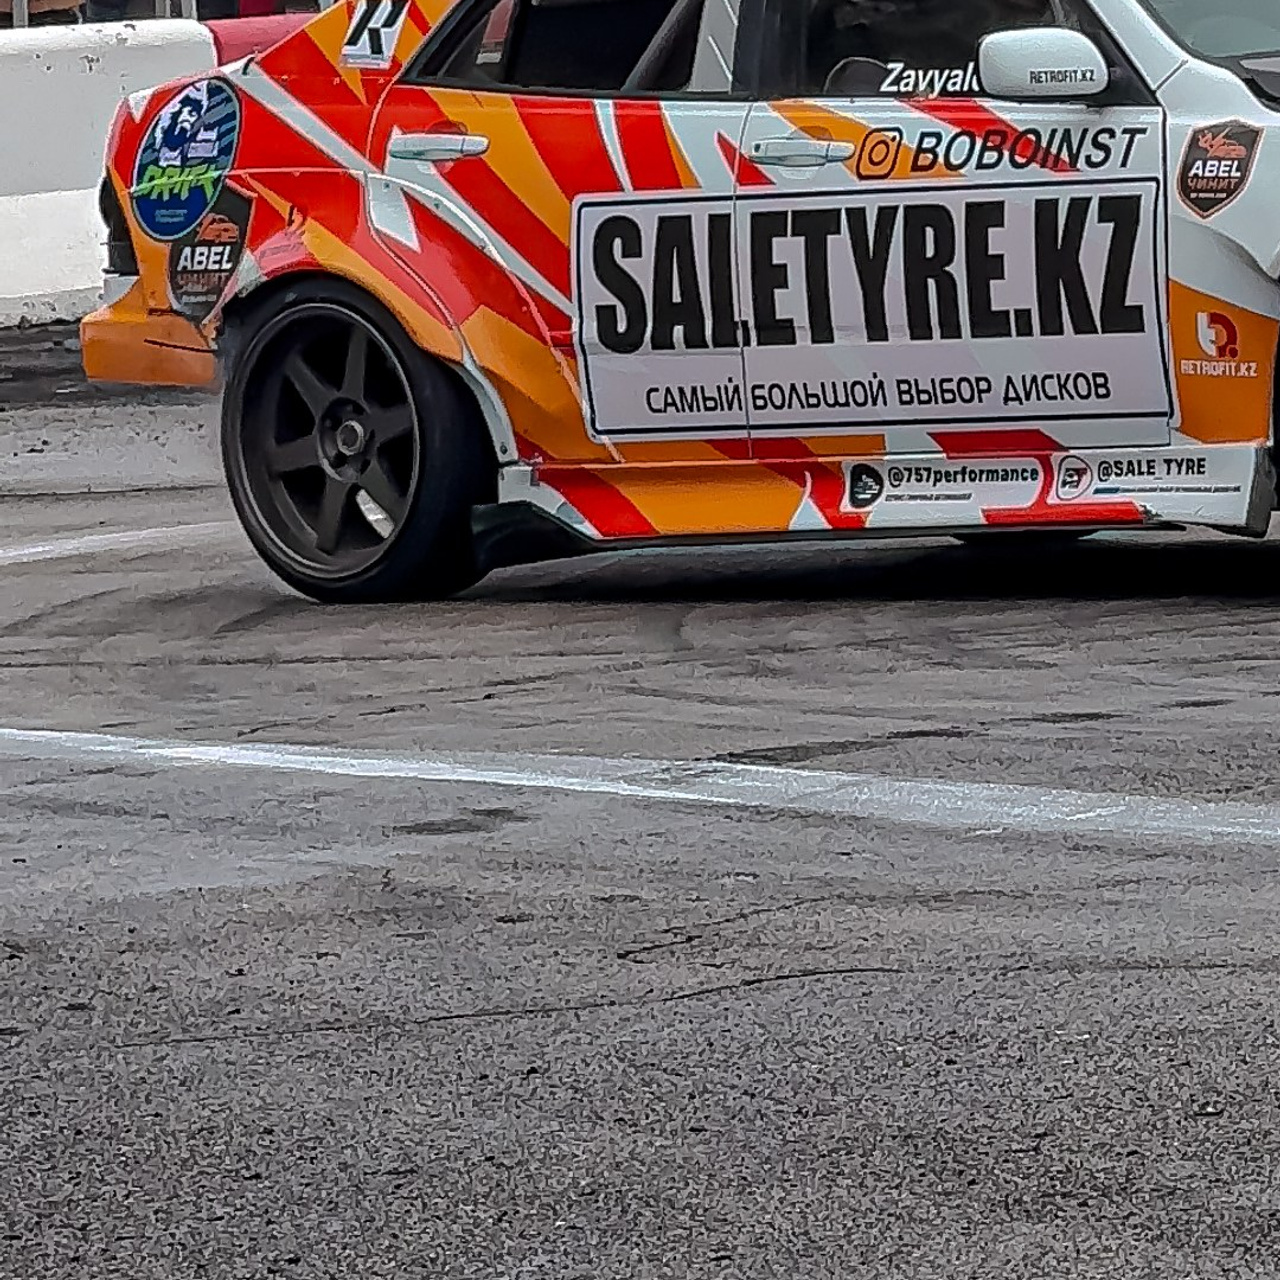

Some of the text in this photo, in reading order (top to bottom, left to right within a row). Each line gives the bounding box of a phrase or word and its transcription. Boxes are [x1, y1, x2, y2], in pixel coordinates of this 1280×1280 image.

[1029, 69, 1095, 84] RETROFIT.KZ
[910, 127, 1151, 173] BOBOINST
[1188, 160, 1241, 177] ABEL
[177, 246, 233, 271] ABEL
[592, 195, 1146, 355] SALETYRE.KZ
[1181, 360, 1258, 377] RETROFIT.KZ
[646, 372, 1112, 414] САМЫЙ БОЛЬШОЙ ВЫБОР ДИСКОВ
[888, 466, 1040, 487] @757performance
